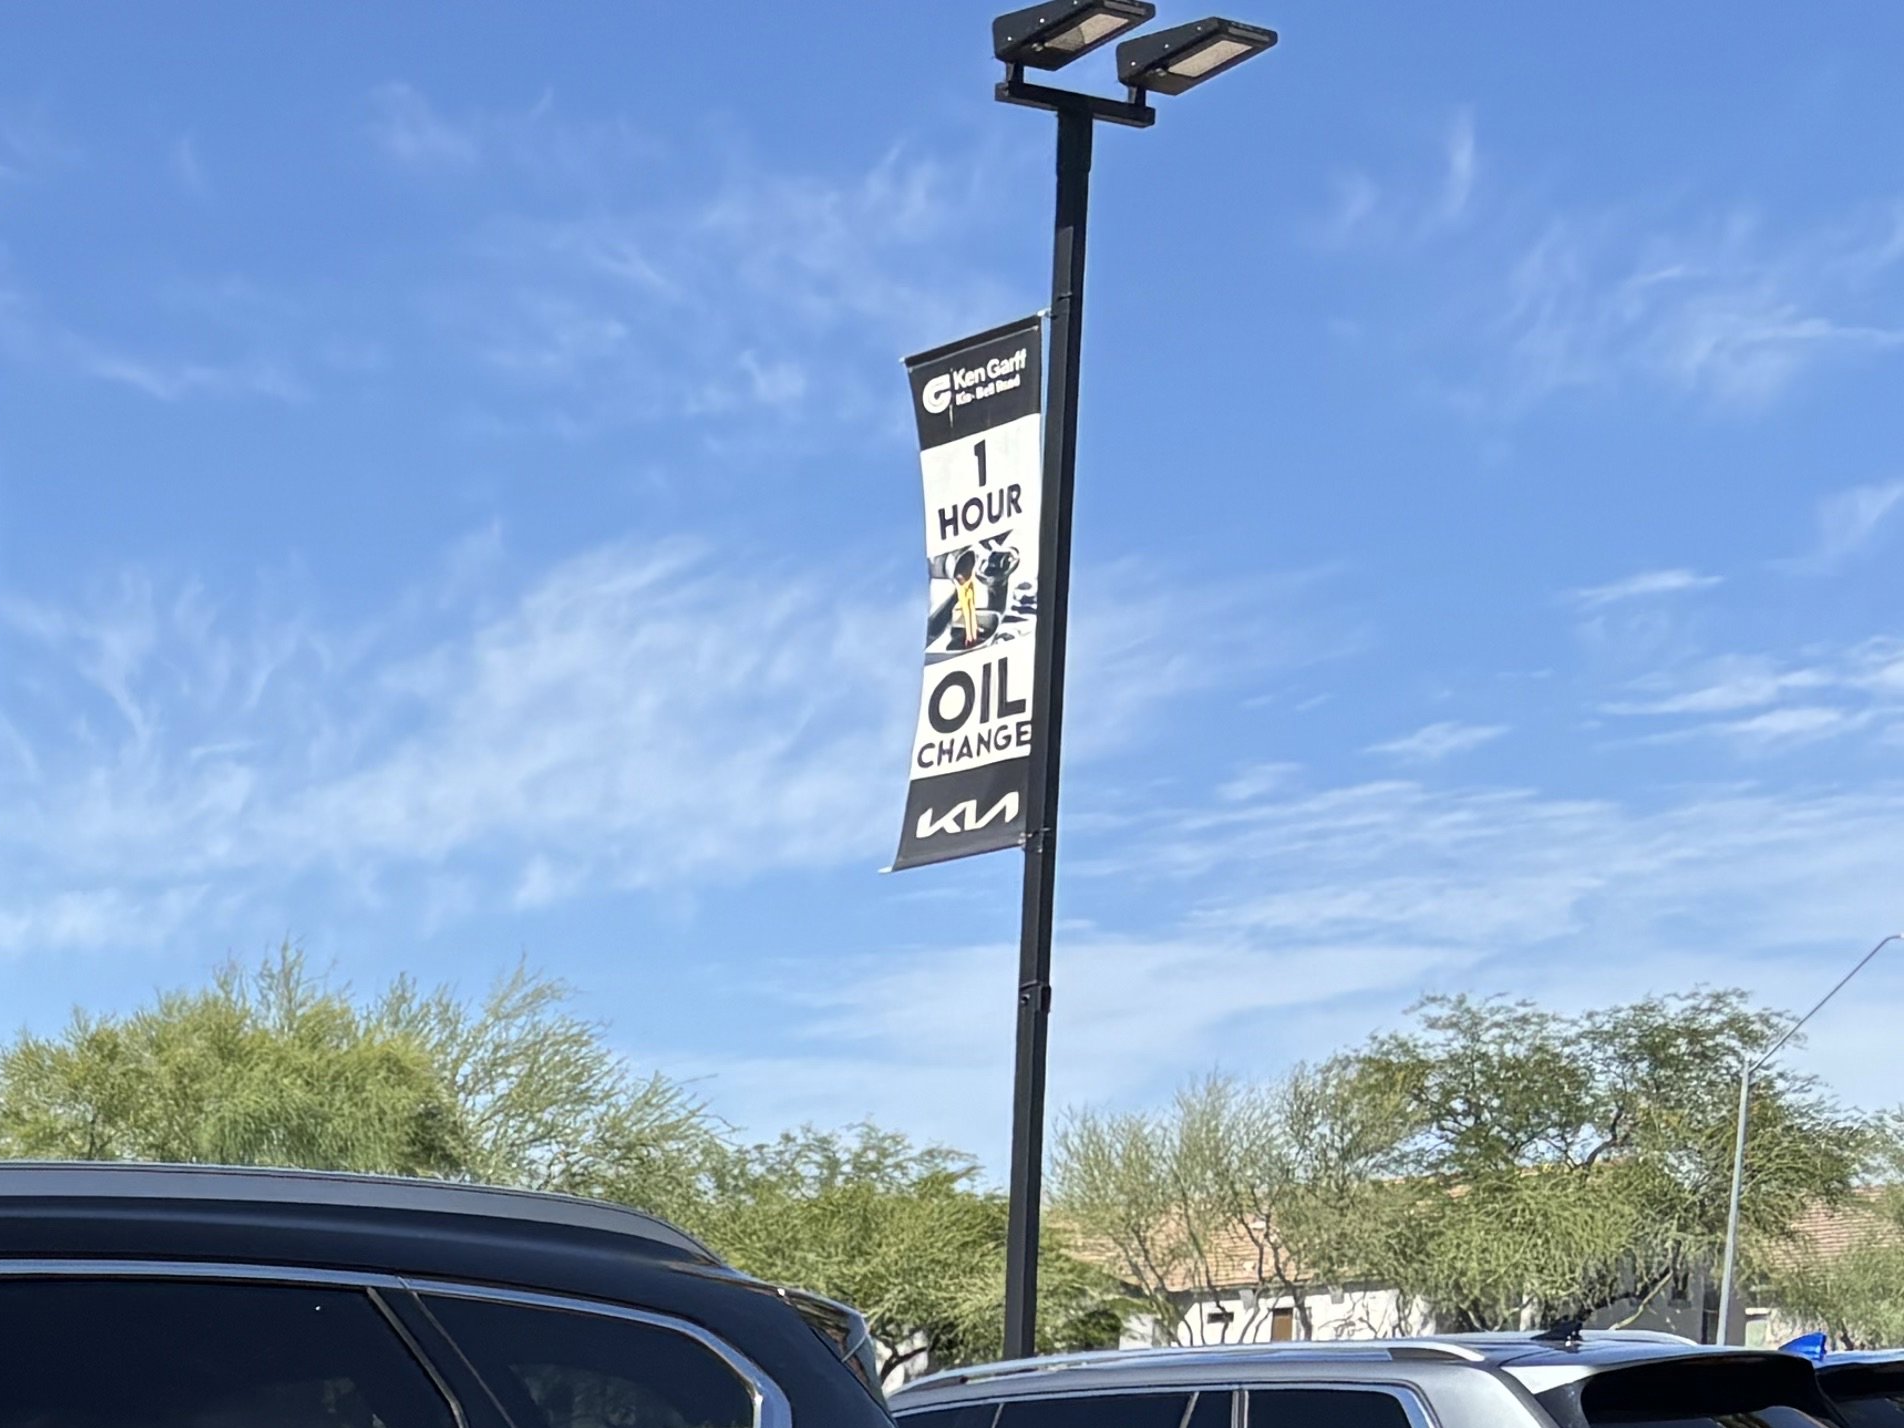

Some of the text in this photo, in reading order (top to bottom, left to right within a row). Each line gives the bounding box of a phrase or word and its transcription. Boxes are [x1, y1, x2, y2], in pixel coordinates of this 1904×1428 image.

[953, 348, 1027, 390] Ken Garff
[976, 382, 995, 400] Bell
[974, 439, 987, 487] 1
[938, 483, 1022, 540] HOUR
[928, 657, 1027, 733] OIL
[917, 720, 1031, 768] CHANGE
[916, 791, 1019, 838] KIA
